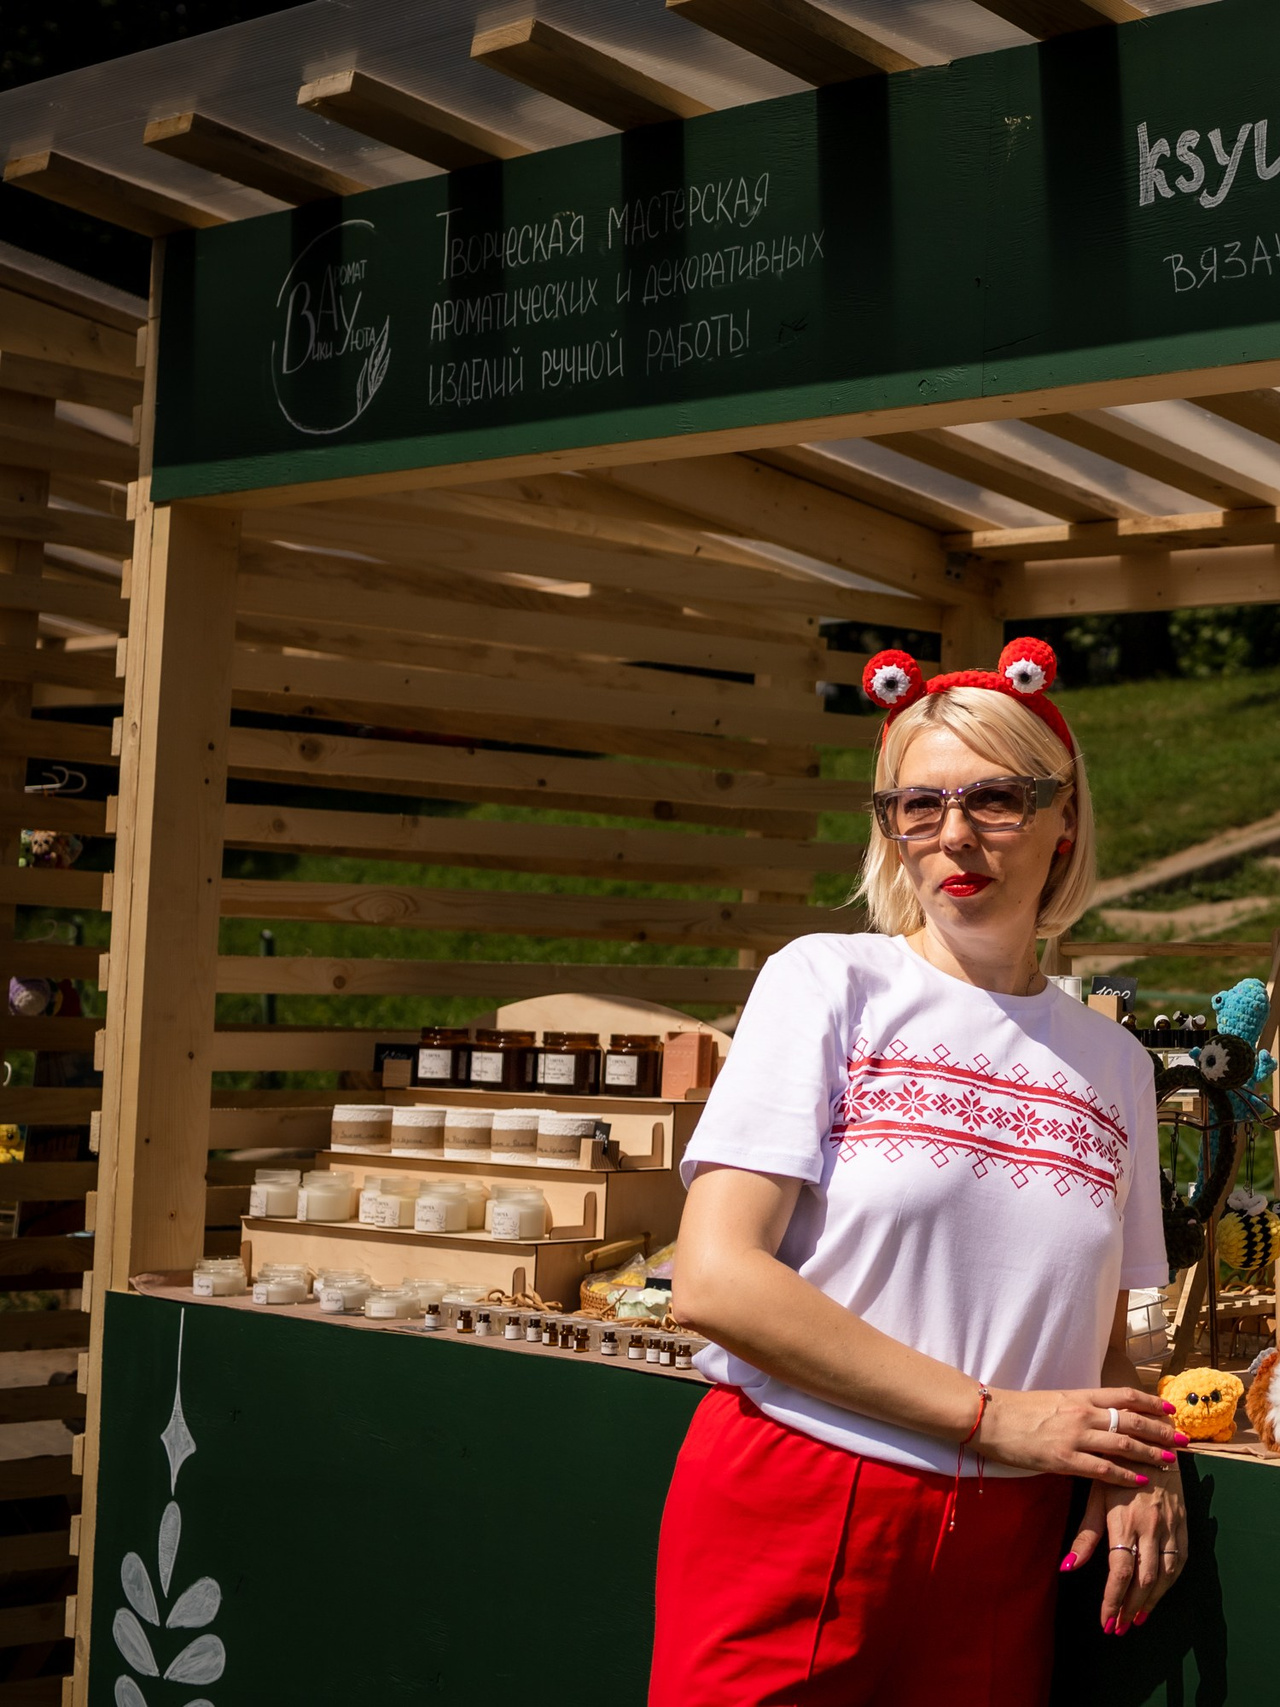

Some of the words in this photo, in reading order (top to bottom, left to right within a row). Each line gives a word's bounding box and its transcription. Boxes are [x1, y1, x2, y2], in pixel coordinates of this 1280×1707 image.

[428, 347, 524, 408] ИЗДЕЛИЙ
[540, 329, 624, 391] РУЧНОЙ
[645, 308, 750, 377] РАБОТЫ
